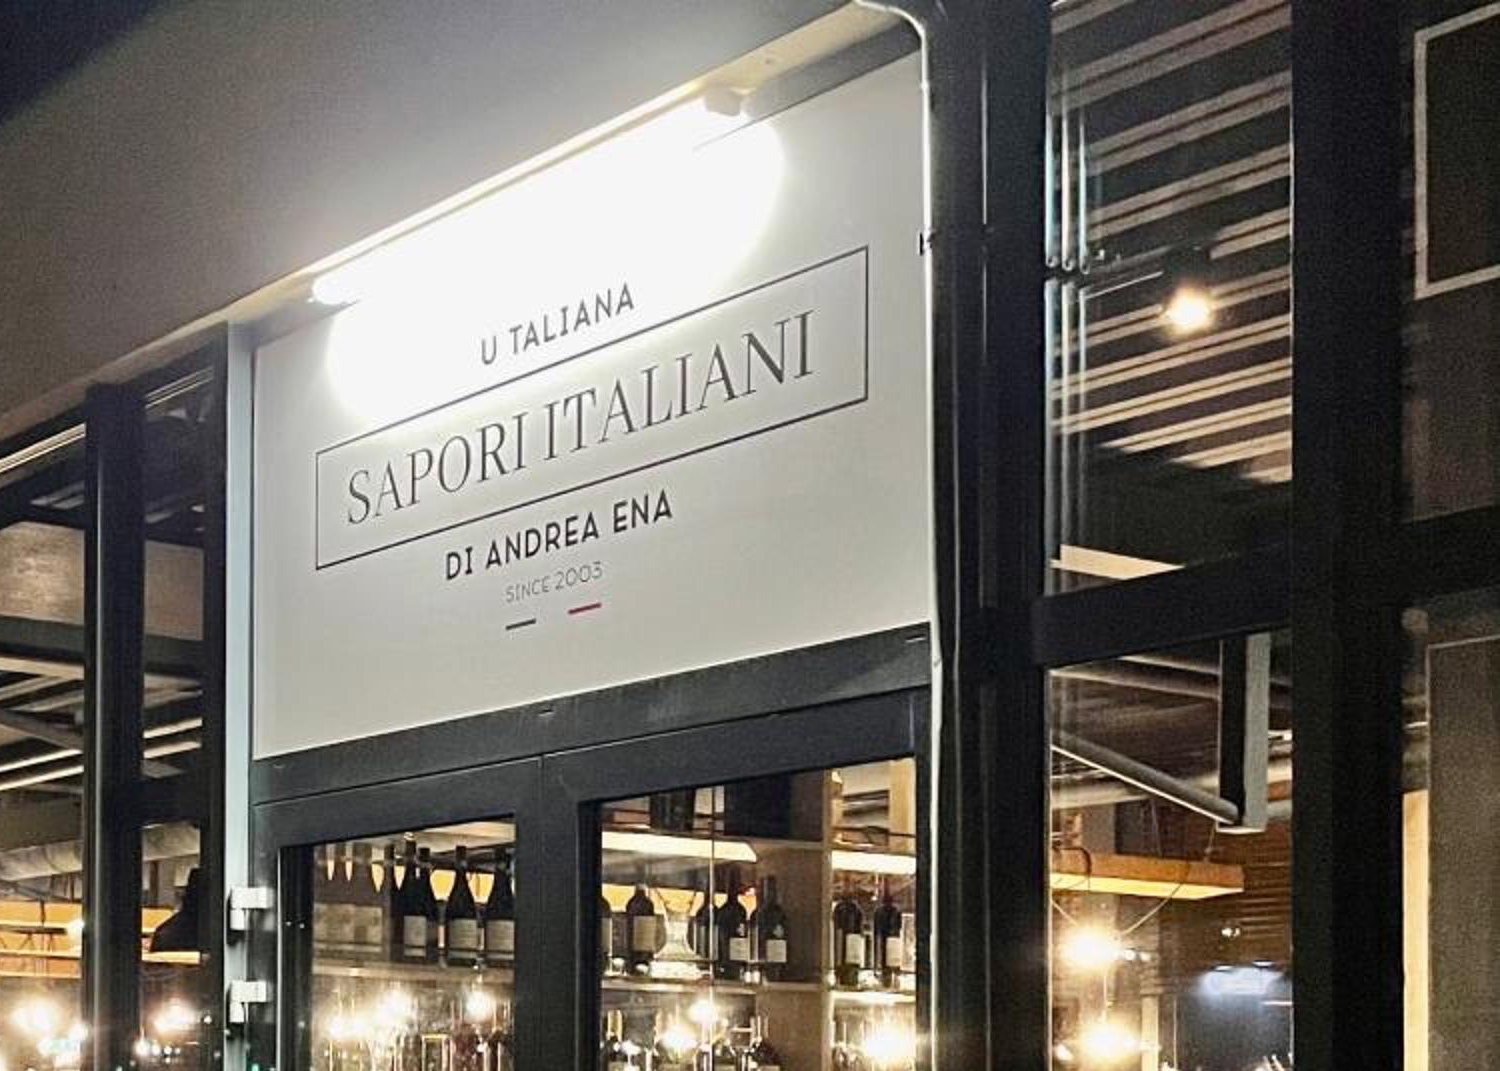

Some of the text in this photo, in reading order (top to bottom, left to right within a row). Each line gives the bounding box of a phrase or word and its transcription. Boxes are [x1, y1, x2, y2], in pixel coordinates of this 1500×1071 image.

[481, 281, 634, 365] U TALIANA
[348, 309, 816, 524] SAPORI ITALIANI
[445, 490, 672, 580] DI ANDREA ENA
[505, 561, 603, 603] SINCE 2003
